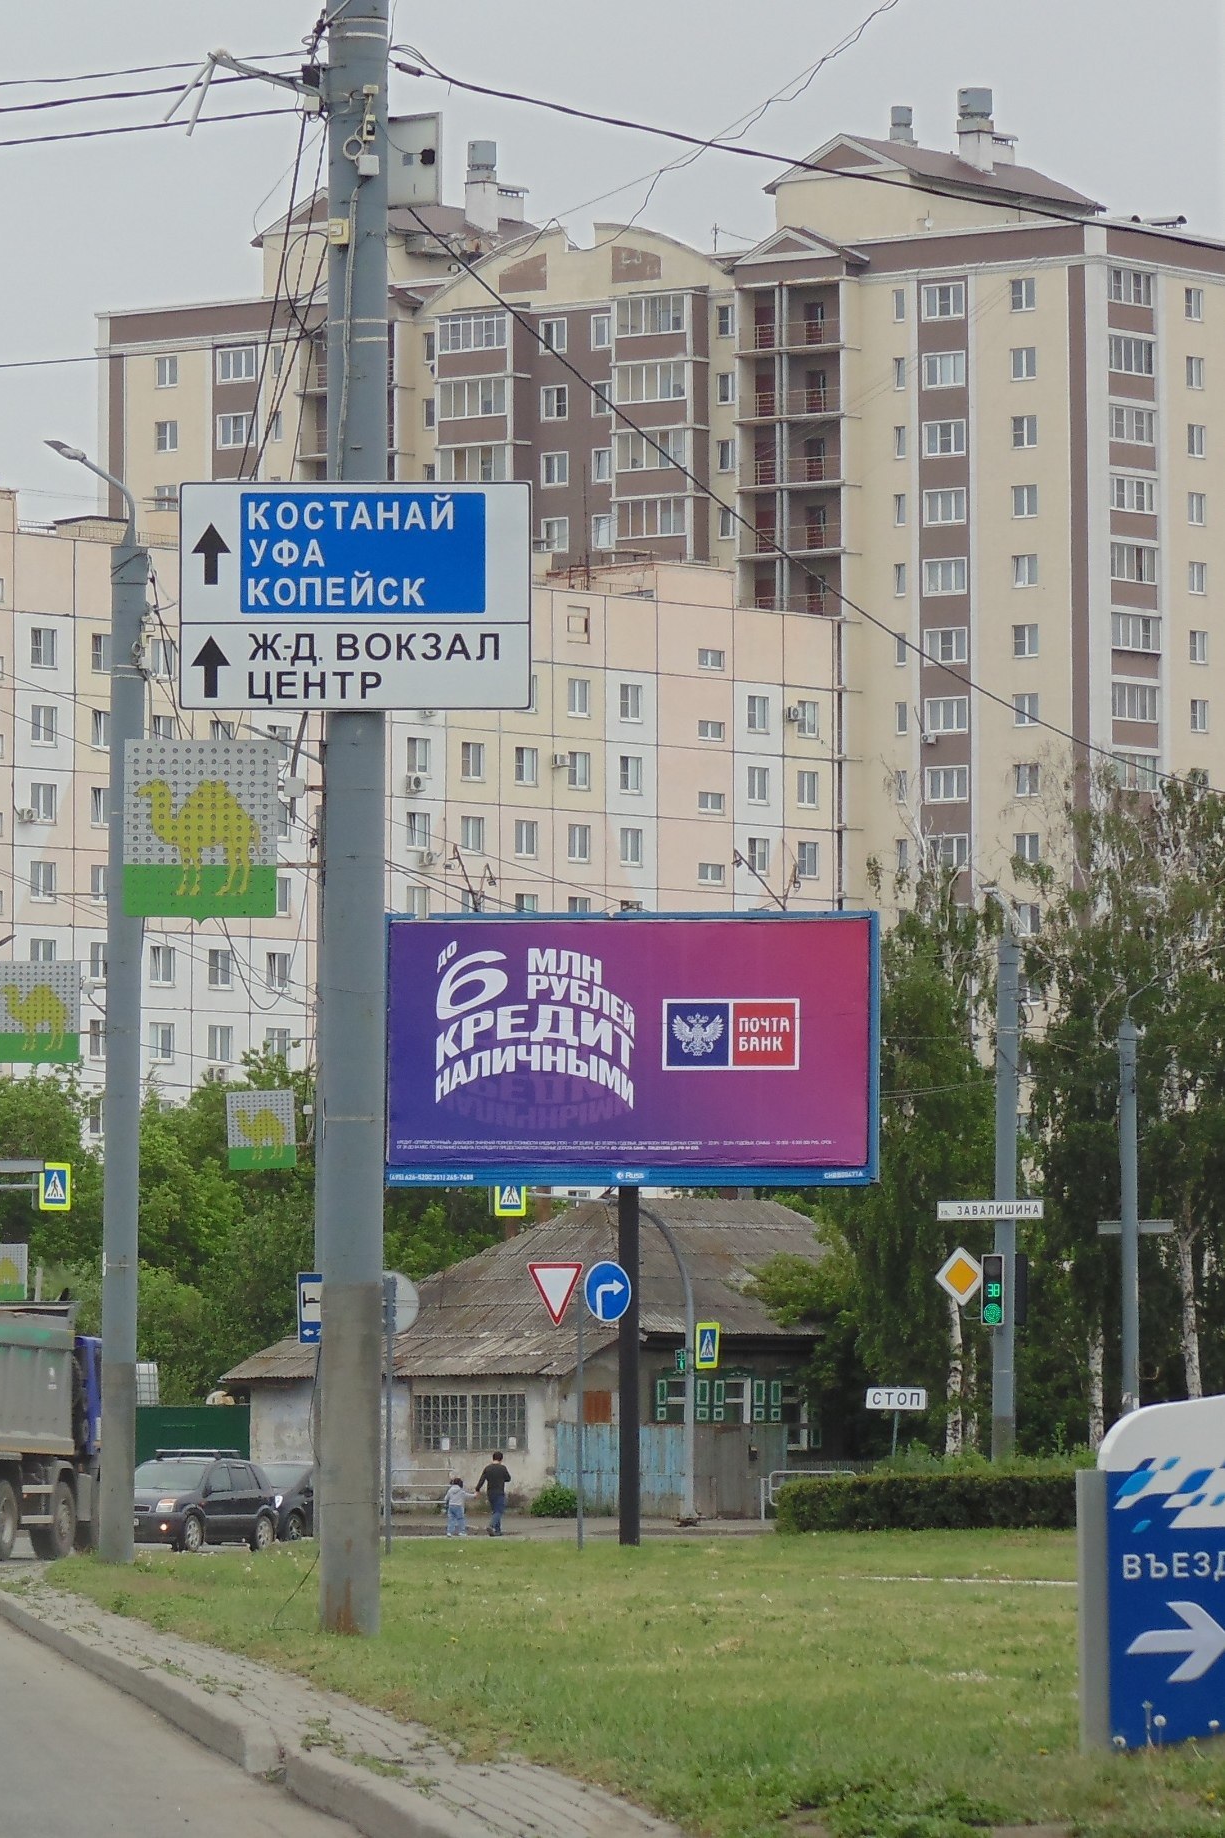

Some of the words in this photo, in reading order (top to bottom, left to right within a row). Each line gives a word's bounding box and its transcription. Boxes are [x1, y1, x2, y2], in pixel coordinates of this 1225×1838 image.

[247, 494, 454, 530] КОСТАНАЙ
[249, 539, 325, 568] УФА
[247, 570, 426, 606] КОПЕЙСК
[336, 633, 501, 662] ВОКЗАЛ
[248, 671, 382, 705] ЦЕНТР
[437, 940, 457, 974] ДО
[436, 950, 509, 1020] 6
[527, 948, 602, 985] МЛН
[527, 974, 635, 1039] РУБЛЕЙ
[436, 1004, 635, 1071] КРЕДИТ
[738, 1017, 790, 1033] ПОЧТА
[738, 1036, 783, 1052] БАНК
[435, 1044, 634, 1110] НАЛИЧНЫМИ
[956, 1204, 1039, 1216] ЗАВАЛИШИНА
[987, 1283, 1000, 1298] 38
[871, 1391, 921, 1406] СТОП
